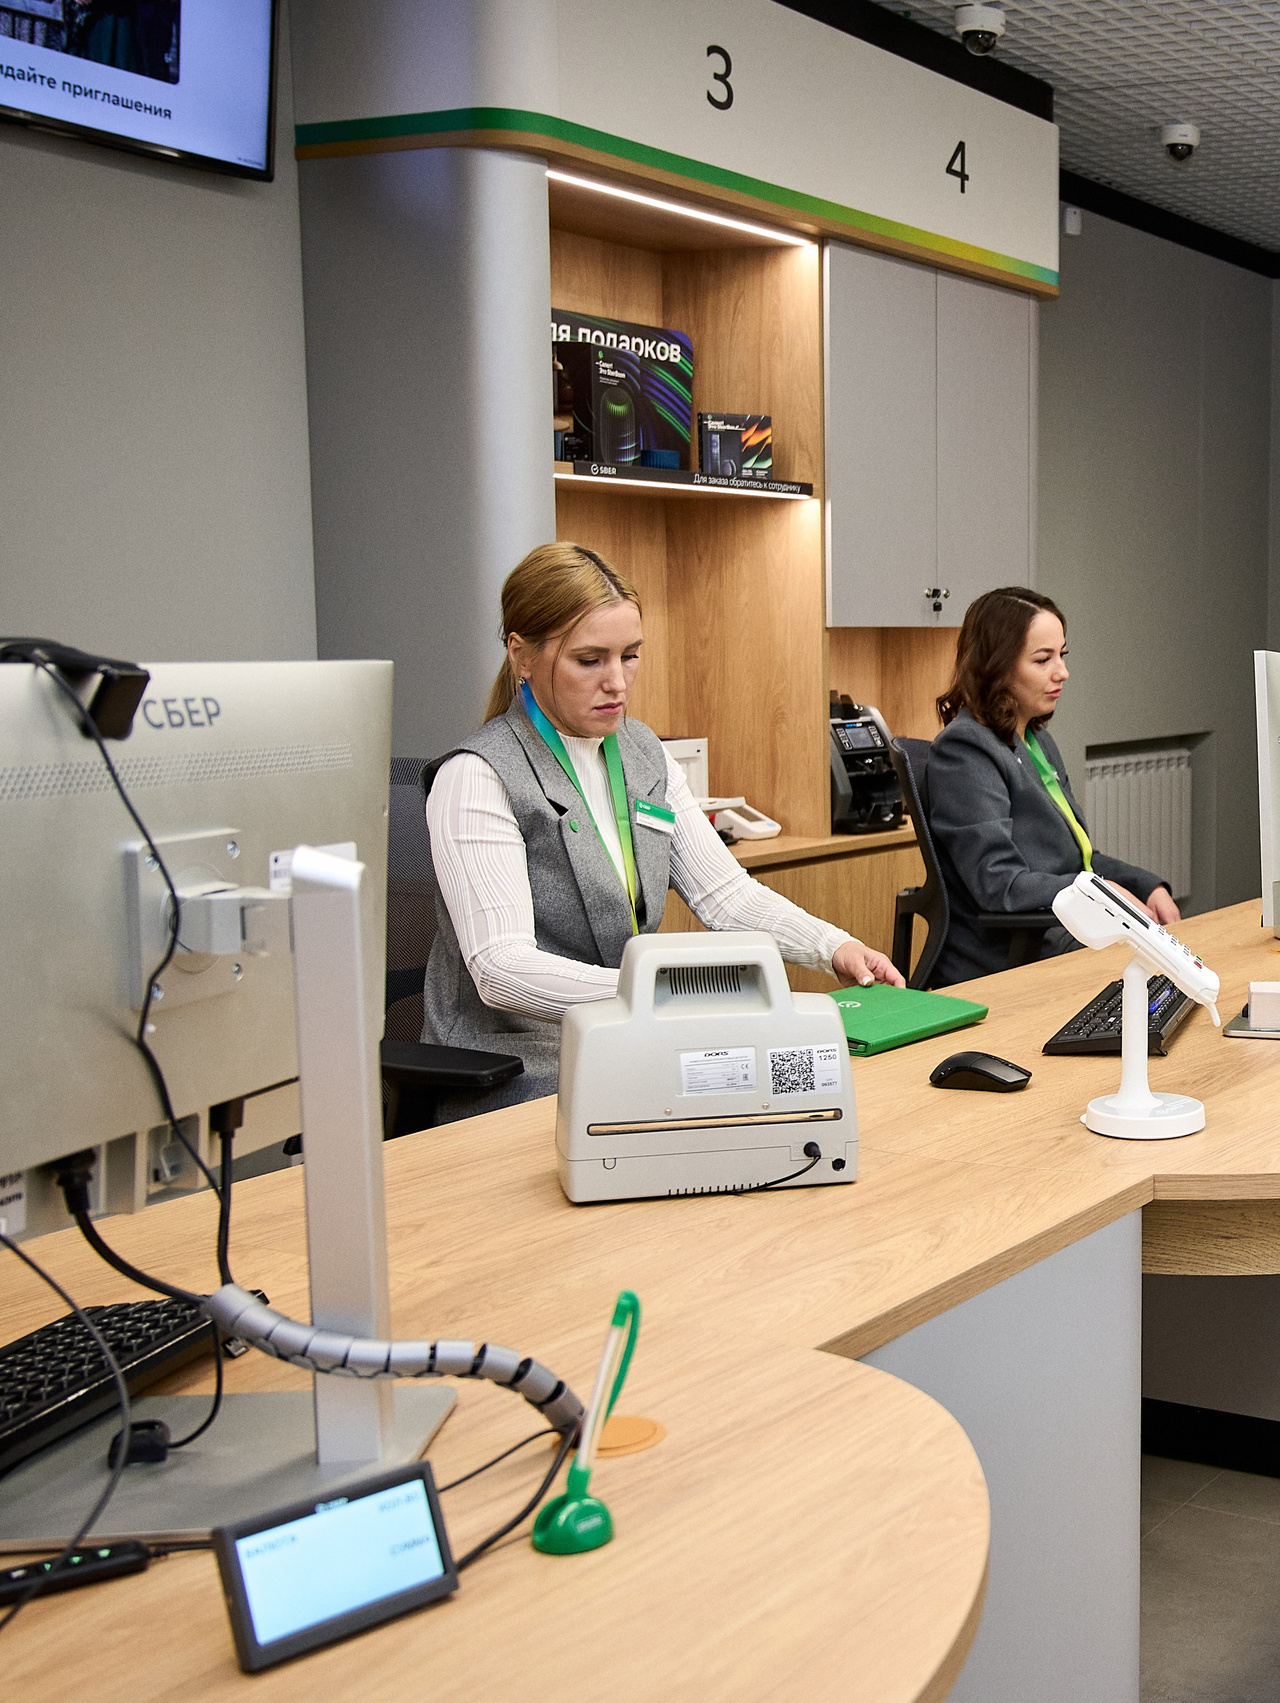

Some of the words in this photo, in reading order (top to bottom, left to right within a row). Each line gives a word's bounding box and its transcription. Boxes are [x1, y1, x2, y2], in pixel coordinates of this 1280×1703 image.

[706, 44, 734, 111] 3
[61, 80, 173, 120] приглашения
[945, 140, 970, 194] 4
[577, 326, 681, 363] подарков
[599, 466, 617, 476] SBER
[693, 473, 708, 484] Для
[707, 476, 729, 487] заказа
[729, 477, 764, 490] обратитесь
[768, 482, 802, 494] сотруднику
[143, 697, 221, 729] СБЕР
[818, 1053, 837, 1061] 1250
